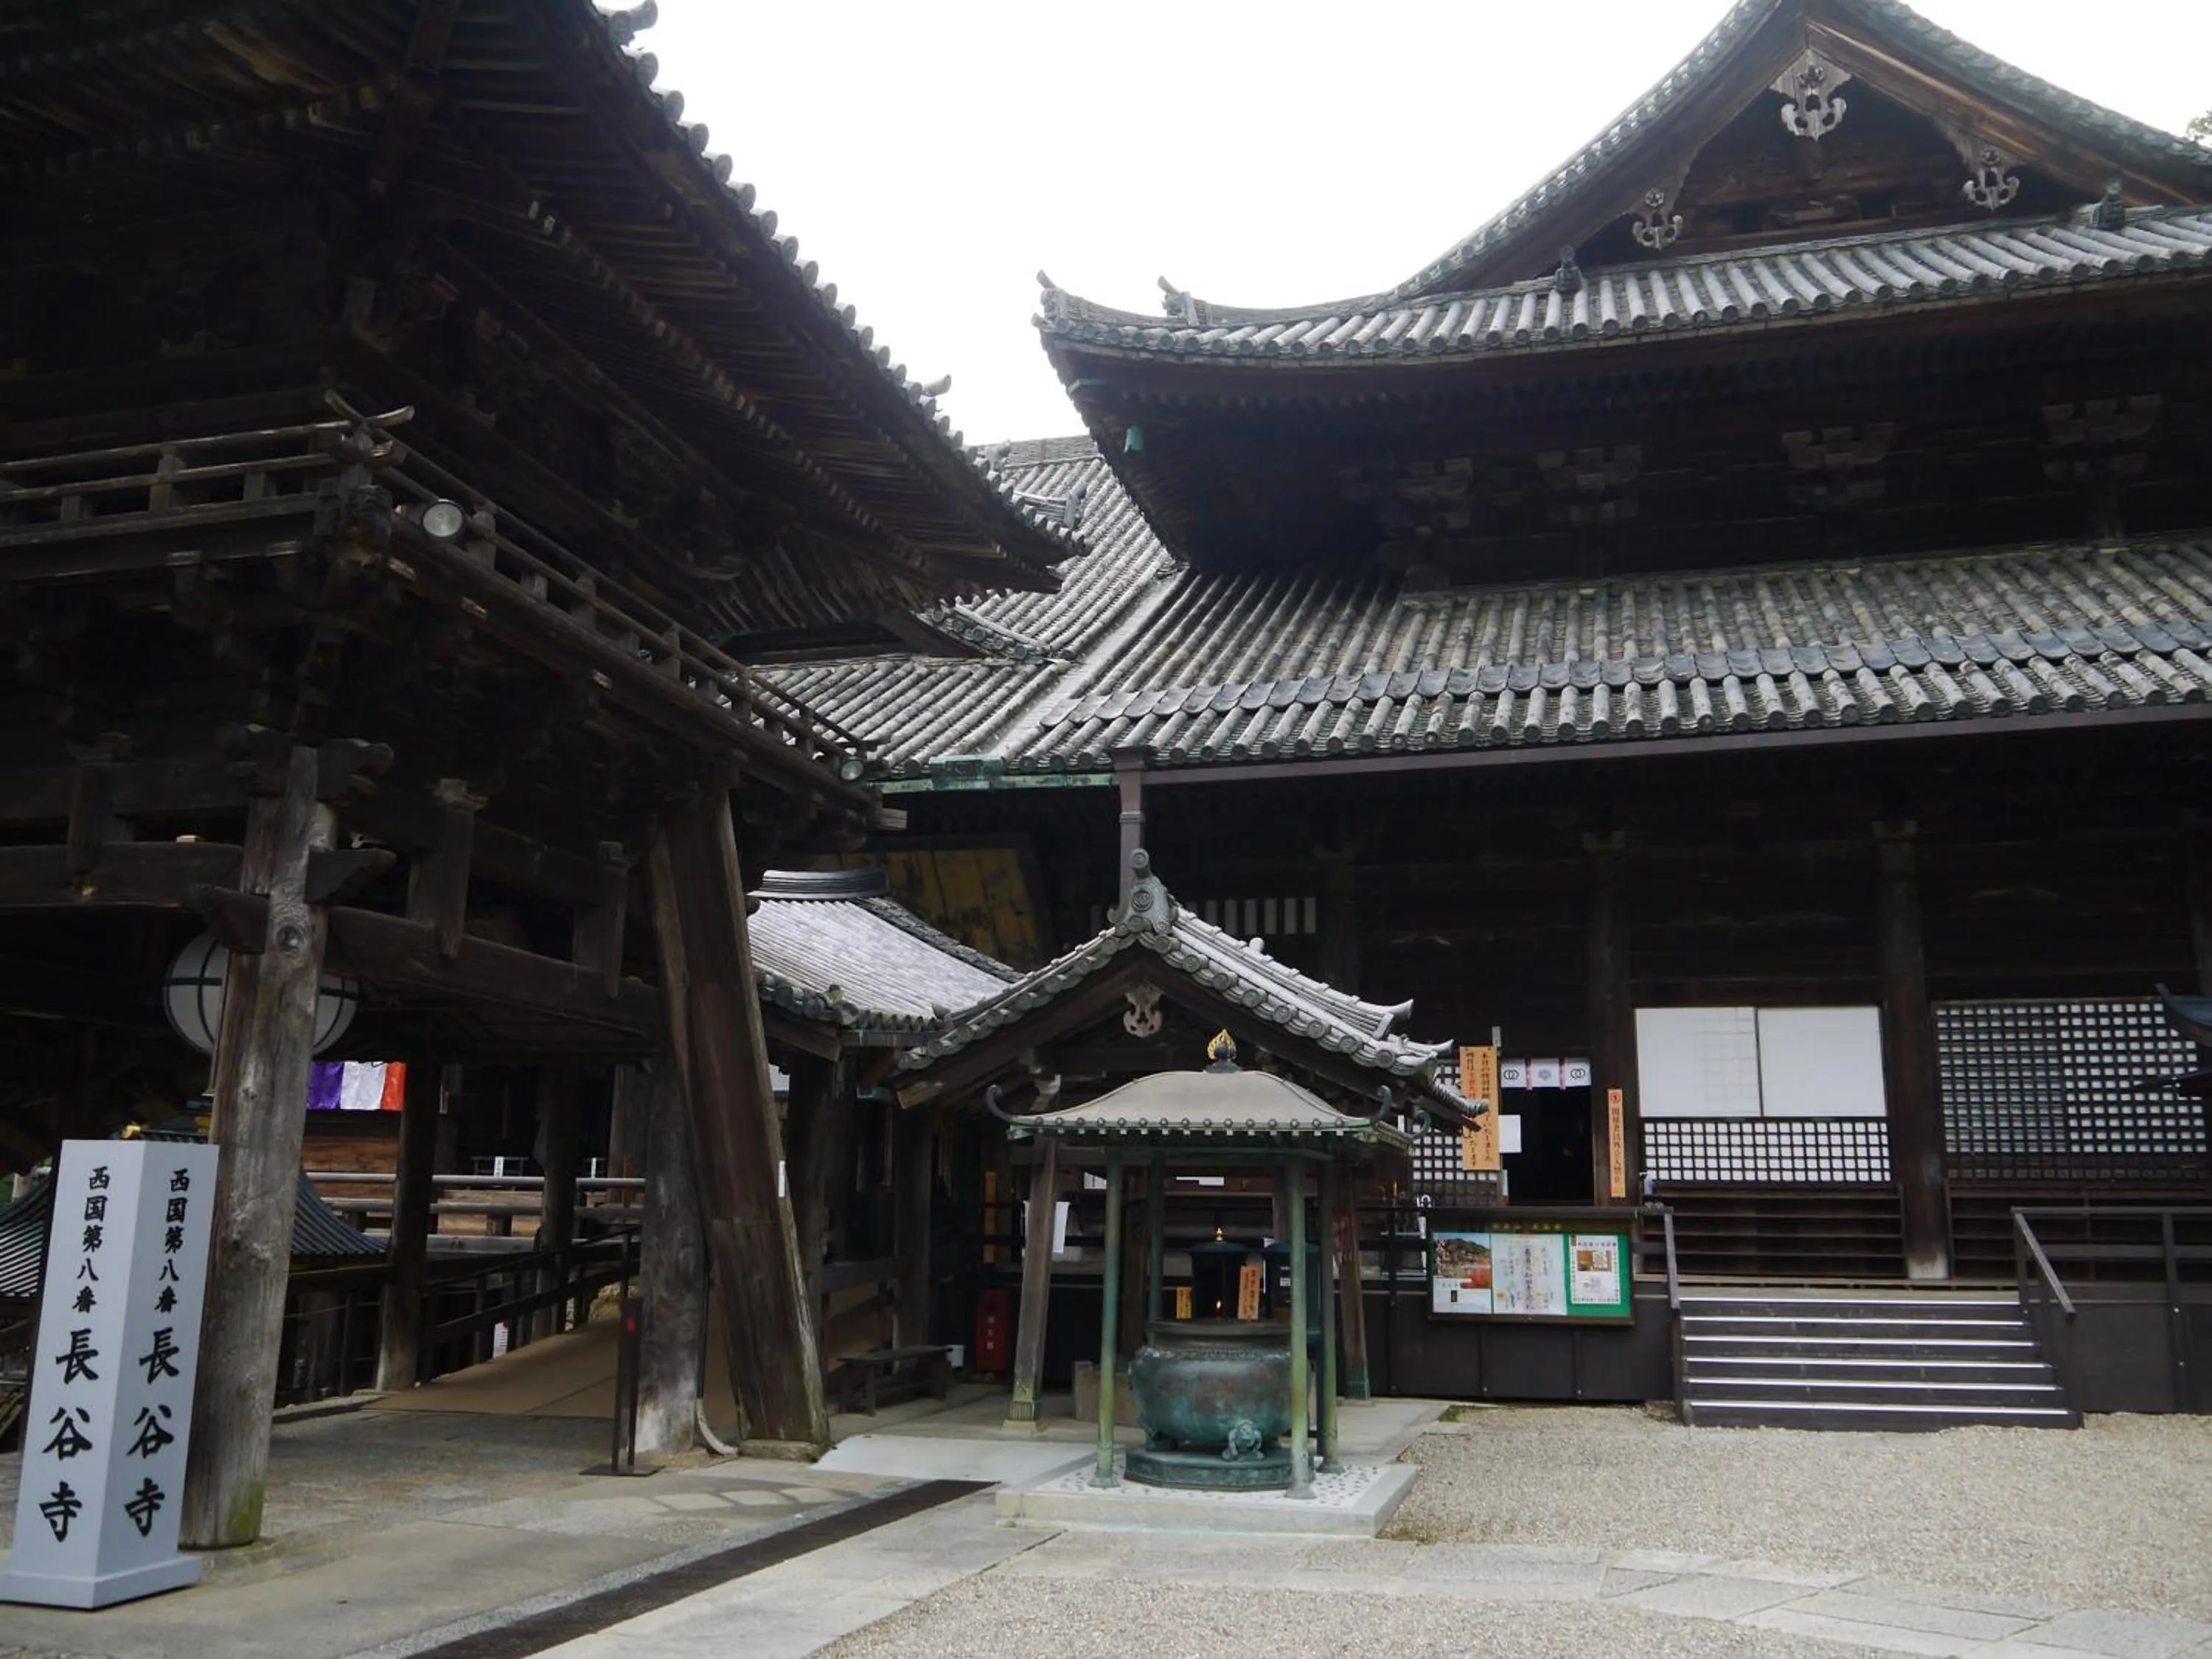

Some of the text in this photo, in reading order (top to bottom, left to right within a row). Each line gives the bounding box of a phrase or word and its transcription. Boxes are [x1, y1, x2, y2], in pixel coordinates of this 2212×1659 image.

[39, 1166, 111, 1543] 西国第八番長谷寺
[124, 1168, 190, 1538] 西国第八番長谷寺
